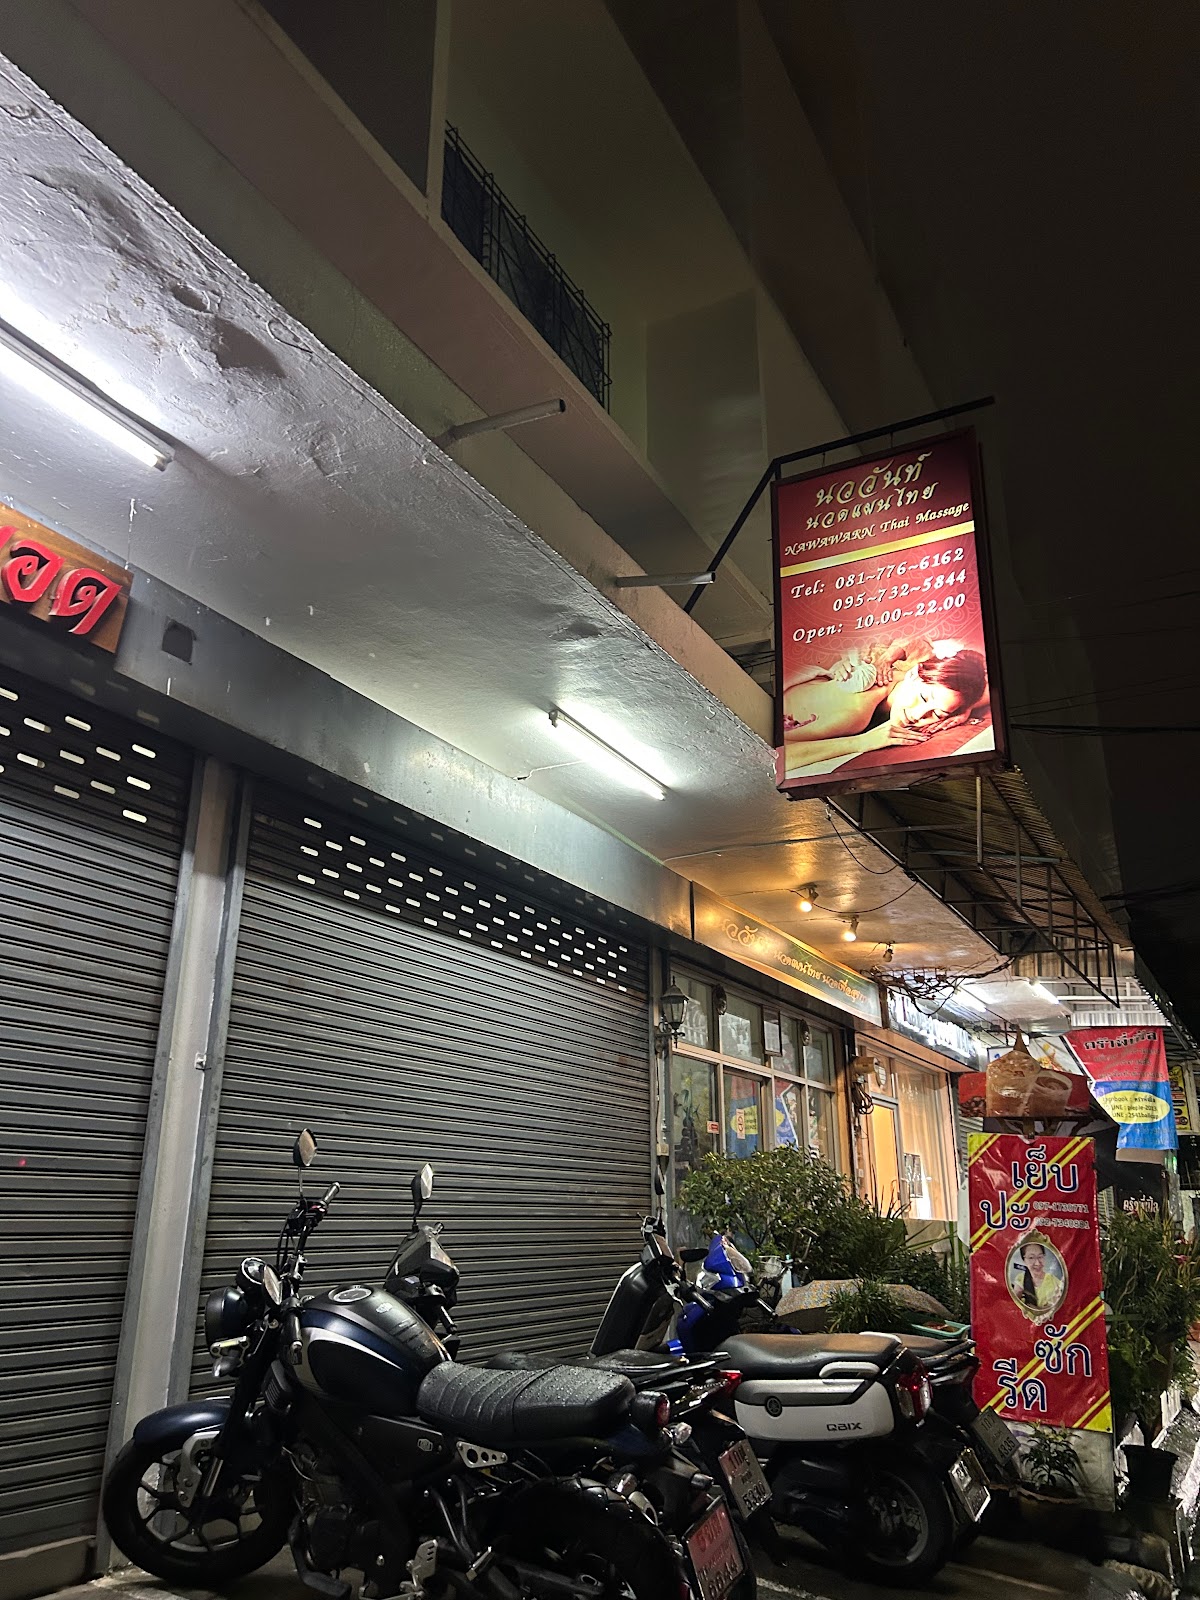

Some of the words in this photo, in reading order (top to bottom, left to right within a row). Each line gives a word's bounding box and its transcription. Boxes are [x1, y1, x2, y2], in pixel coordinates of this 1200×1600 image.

[815, 452, 932, 507] นววันท์
[784, 525, 876, 556] NAWAWARN
[880, 516, 910, 533] Thai
[915, 502, 970, 525] Massage
[805, 482, 939, 530] นวดแผนไทย
[791, 580, 825, 599] Tel:
[793, 621, 844, 644] Open:
[1011, 1144, 1079, 1193] เย็บ
[980, 1190, 1031, 1230] ปะ
[1035, 1324, 1093, 1377] ซัก
[993, 1358, 1048, 1412] รีด
[826, 1422, 863, 1432] QBIX
